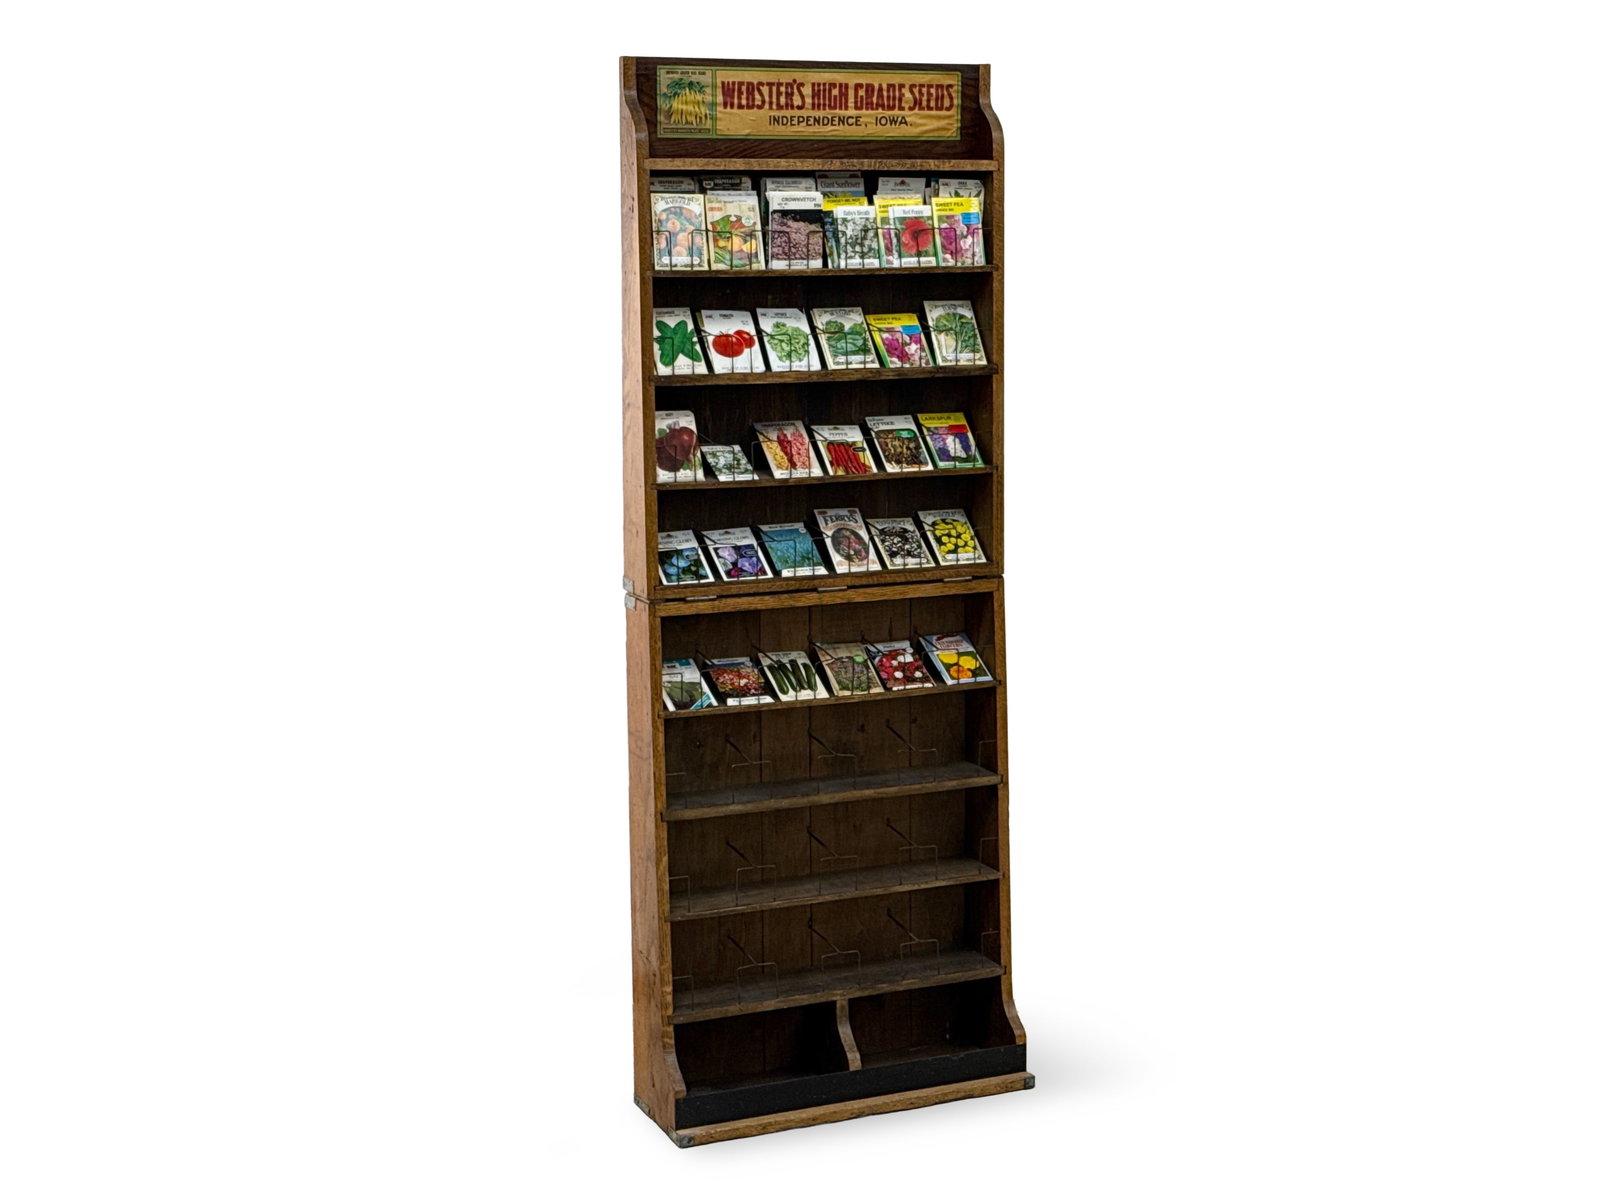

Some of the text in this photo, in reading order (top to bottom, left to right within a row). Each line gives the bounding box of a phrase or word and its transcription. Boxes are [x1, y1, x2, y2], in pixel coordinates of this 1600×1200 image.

[720, 79, 954, 111] WEBSTER'S HIGH GRADE SEEDS
[875, 115, 913, 127] IOWA.
